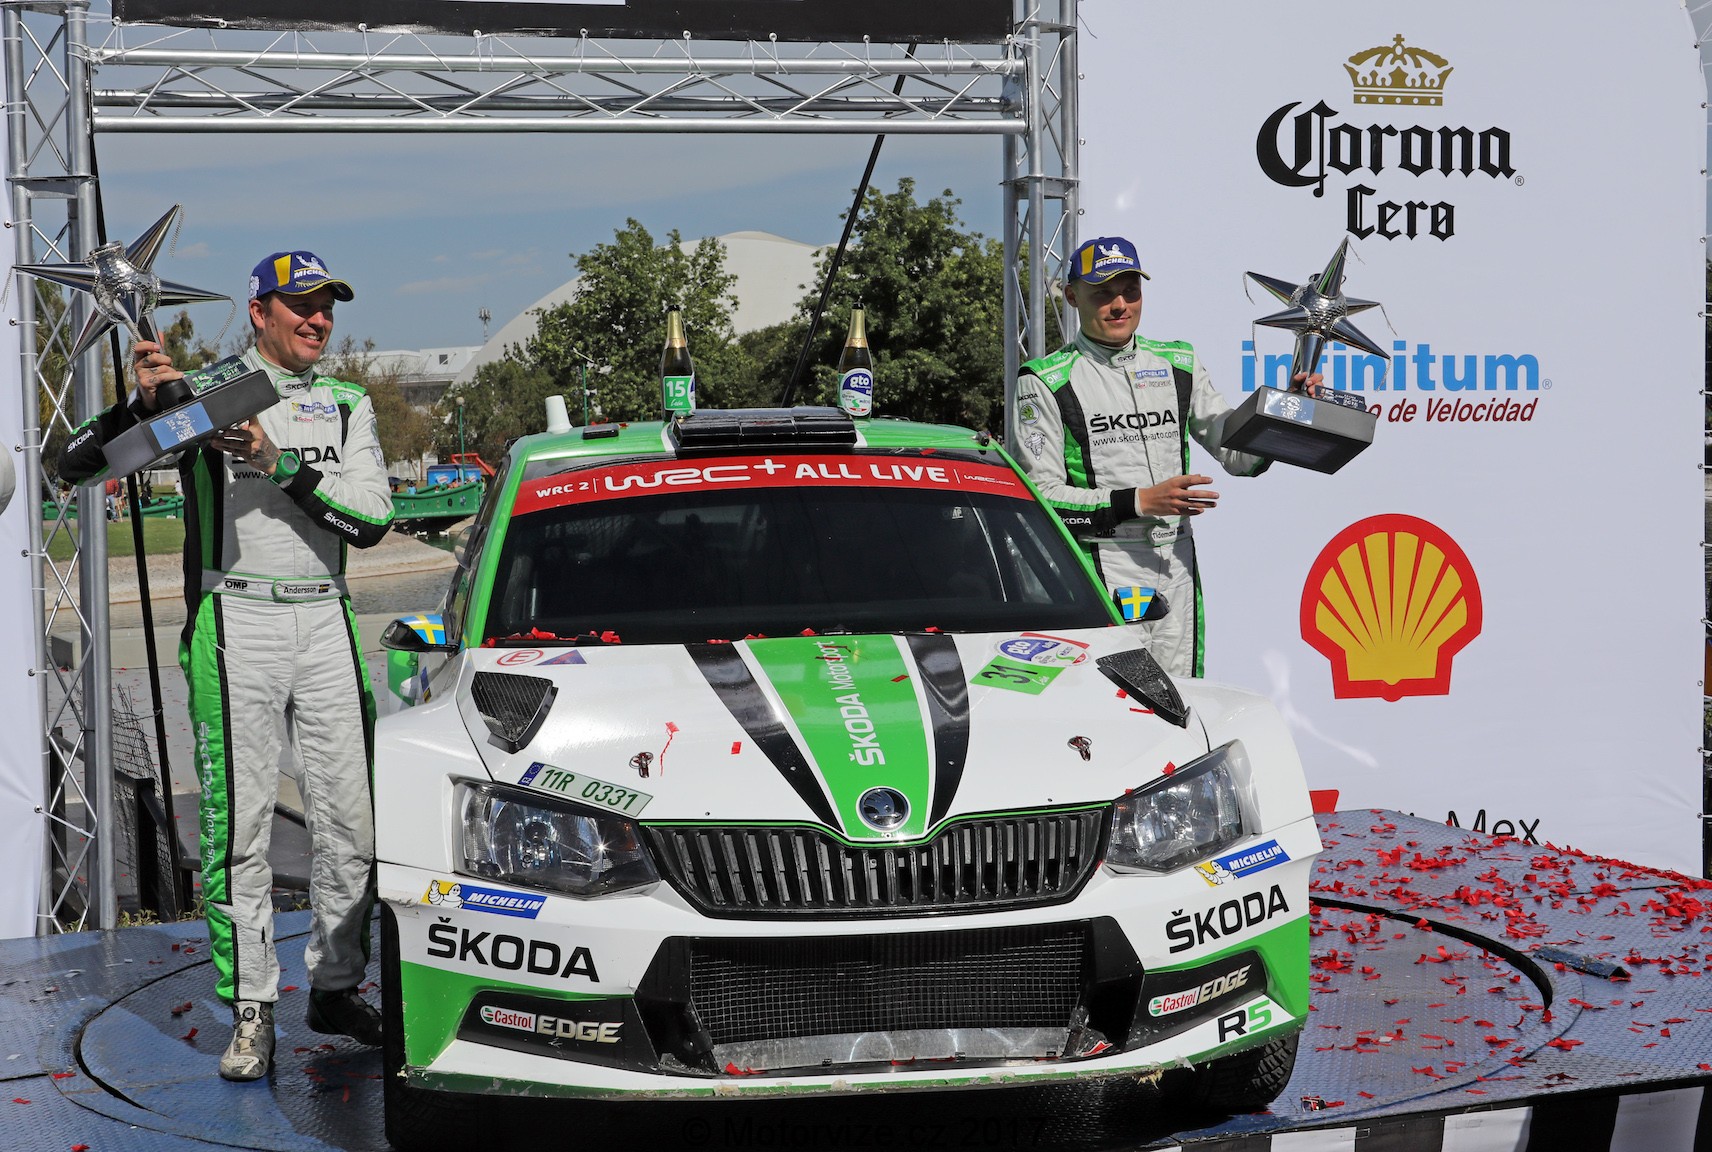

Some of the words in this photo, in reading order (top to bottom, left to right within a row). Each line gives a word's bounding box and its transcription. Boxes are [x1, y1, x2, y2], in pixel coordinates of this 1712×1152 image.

[1256, 99, 1517, 198] Corona
[1095, 258, 1134, 269] MICHELIN
[666, 380, 686, 397] 15
[850, 375, 870, 388] gto
[1090, 409, 1177, 433] ŠKODA
[1387, 399, 1417, 422] de
[1425, 398, 1539, 423] Velocidad
[536, 483, 574, 498] WRC
[578, 481, 590, 491] 2
[795, 463, 862, 480] ALL
[869, 464, 950, 483] LIVE
[225, 580, 248, 590] OMP
[284, 586, 317, 594] Andersson
[812, 640, 857, 690] Motorsport
[981, 664, 1038, 684] 31
[835, 692, 886, 766] ŠKODA
[540, 769, 576, 792] 11R
[581, 781, 639, 811] 0331
[1228, 845, 1283, 870] MICHELIN
[466, 892, 543, 910] MICHELIN
[1165, 884, 1290, 954] ŠKODA
[427, 916, 600, 983] ŠKODA
[1162, 992, 1197, 1012] Castrol
[1198, 964, 1252, 1004] EDGE
[494, 1010, 533, 1030] Castrol
[537, 1015, 625, 1044] EDGE
[1218, 999, 1273, 1043] R5
